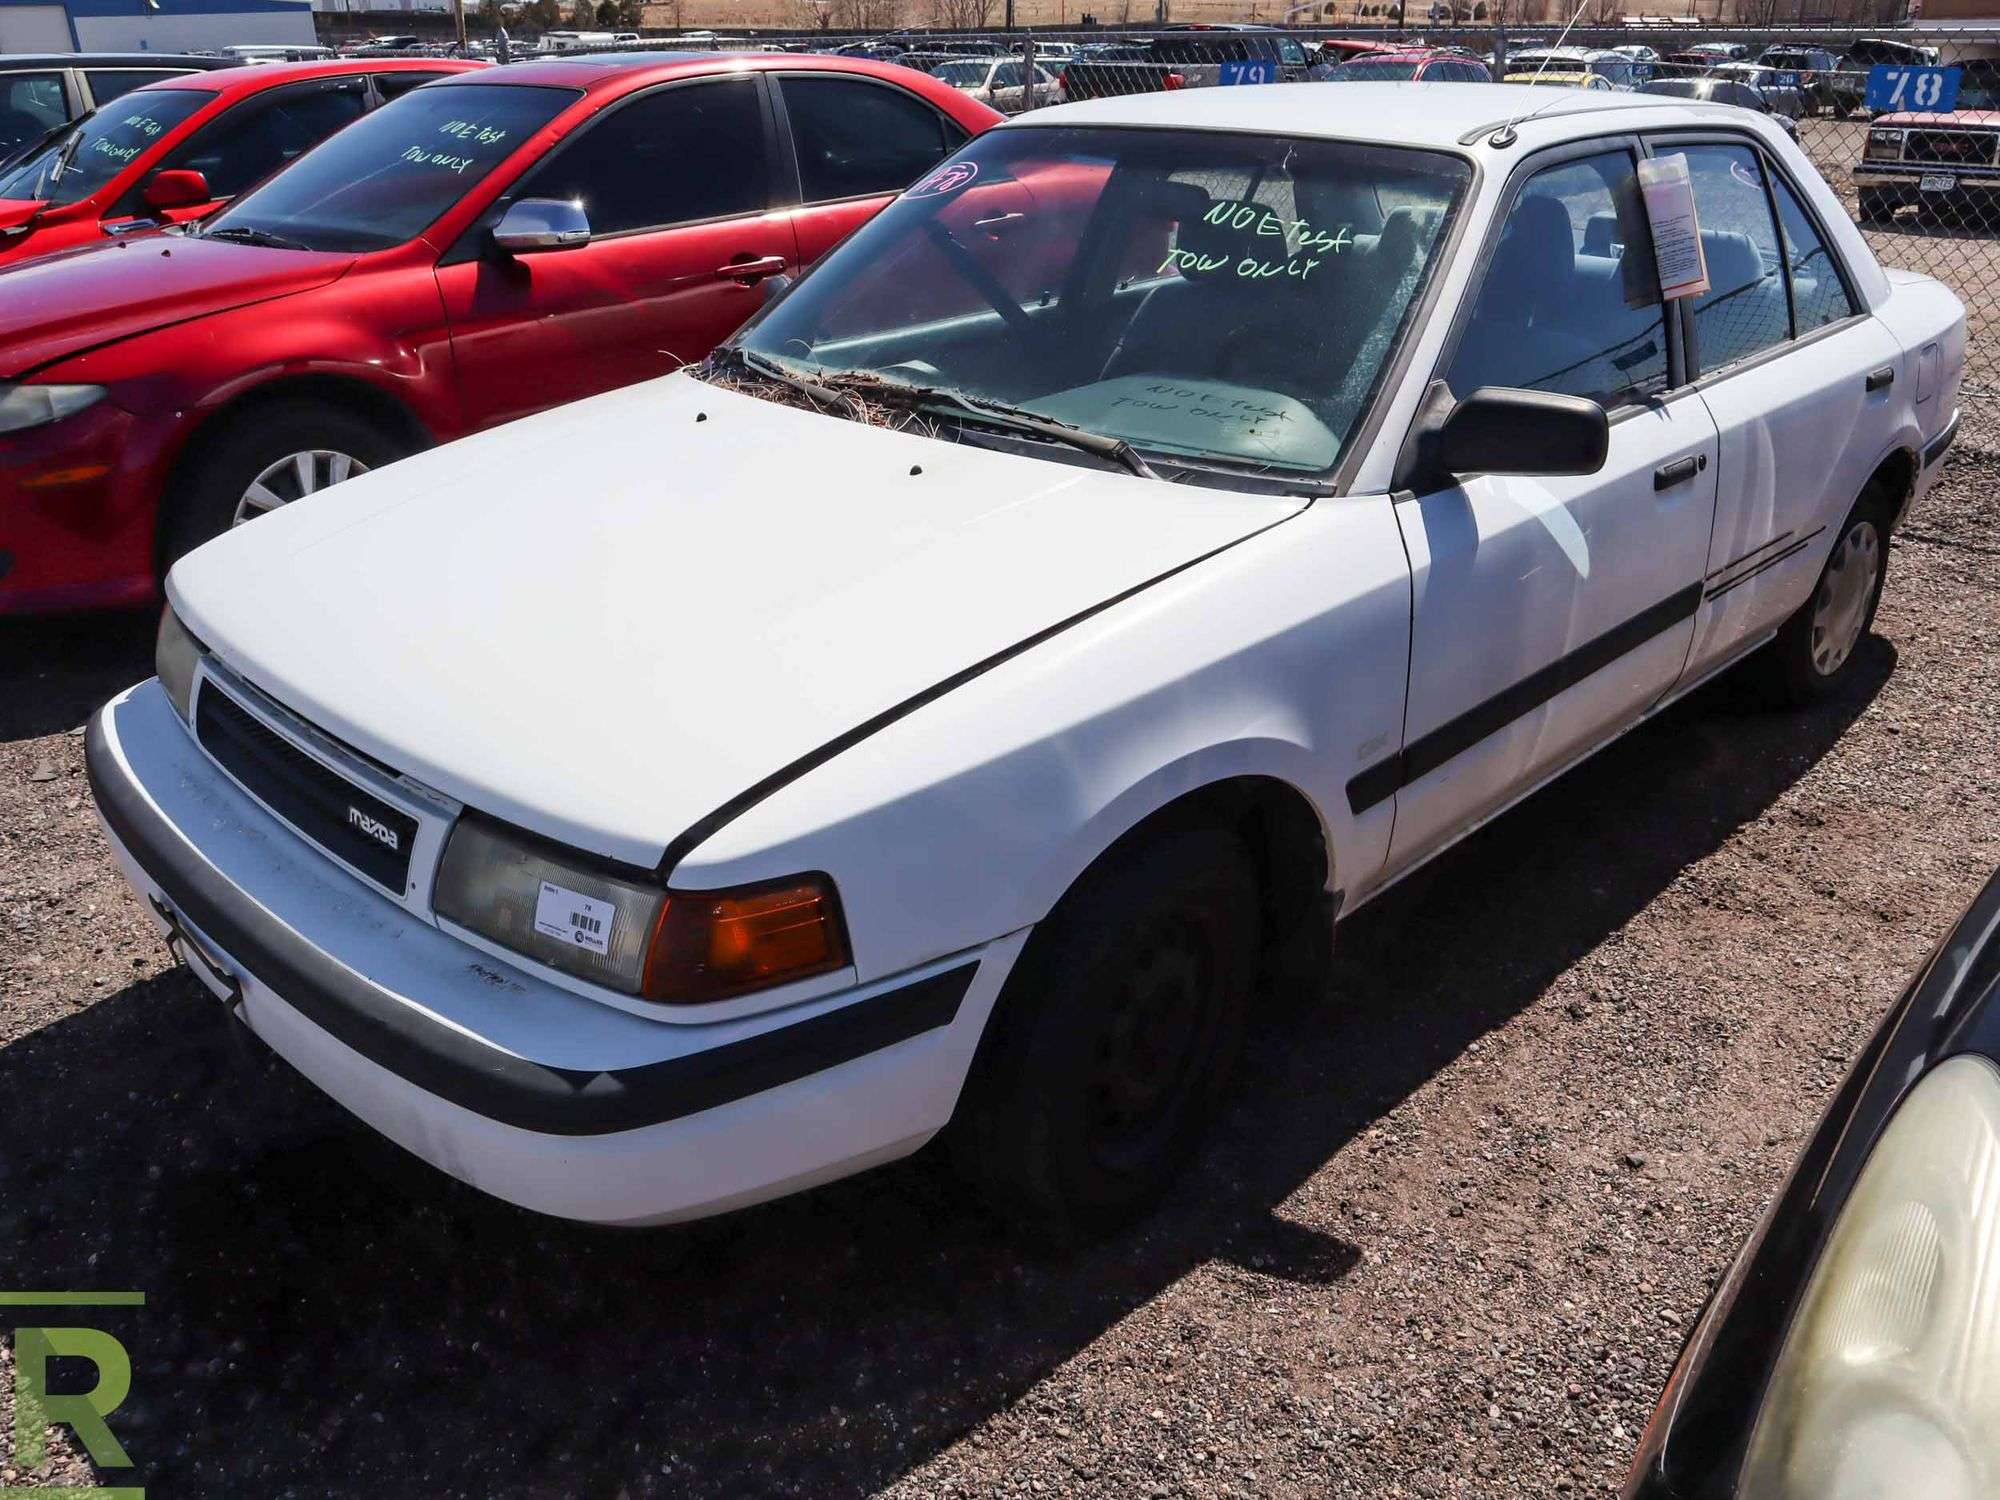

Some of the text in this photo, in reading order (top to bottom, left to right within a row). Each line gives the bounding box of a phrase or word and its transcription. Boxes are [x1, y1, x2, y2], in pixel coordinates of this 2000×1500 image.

[1230, 64, 1266, 85] 79
[1886, 72, 1943, 106] 78
[400, 146, 474, 174] TOW ONLY
[1156, 248, 1321, 280] TOW ONLY
